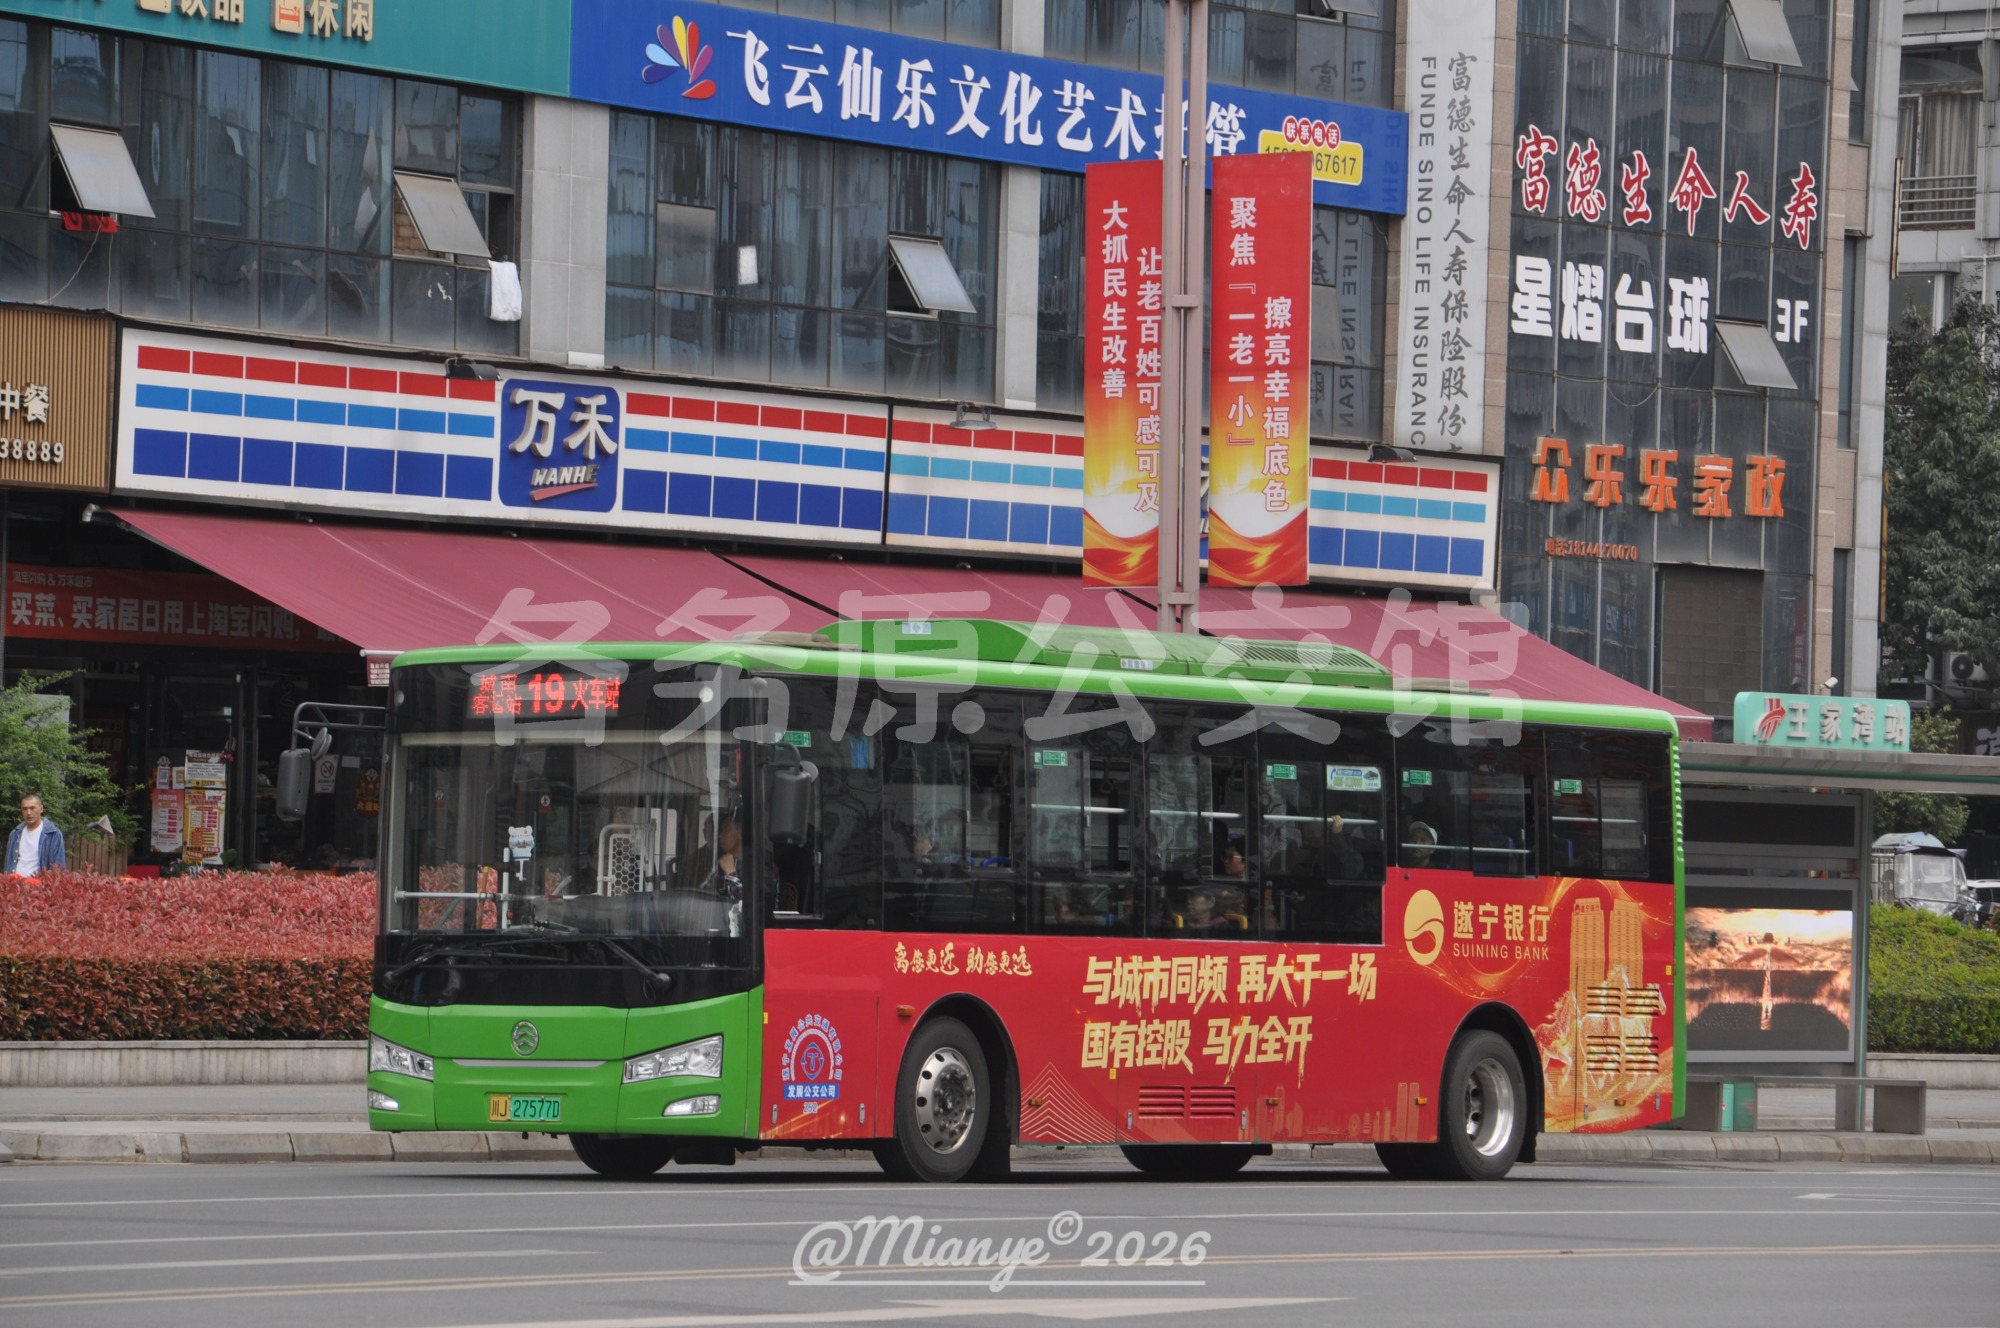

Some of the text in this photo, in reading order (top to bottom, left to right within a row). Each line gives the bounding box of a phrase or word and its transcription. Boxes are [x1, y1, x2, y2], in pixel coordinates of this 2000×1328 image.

[1284, 118, 1340, 147] 联系电话
[1418, 56, 1437, 147] FUNDE
[1416, 159, 1434, 224] SINO
[1515, 123, 1819, 251] 富德生命人寿
[1414, 236, 1431, 294] LIFE
[1437, 51, 1478, 453] 富德生命人寿保险股份
[1101, 201, 1129, 399] 大抓民生改善
[1510, 253, 1810, 354] 星熠台球 3F
[1134, 247, 1163, 513] 让老百姓可感可及
[1262, 297, 1292, 513] 擦亮幸福底色
[509, 388, 618, 460] 万禾
[530, 464, 600, 487] WANHE
[1530, 435, 1786, 519] 众乐乐家政
[528, 673, 565, 714] 19
[571, 677, 621, 710] 火车站
[1788, 702, 1908, 745] 王家湾站
[1453, 901, 1550, 942] 遂宁银行
[1453, 943, 1549, 960] SUINING BANK
[1082, 953, 1377, 1017] 与城市同频 再大干一场
[1081, 1016, 1313, 1089] 国有控股 马力全开
[787, 1085, 836, 1098] 发展公交公司
